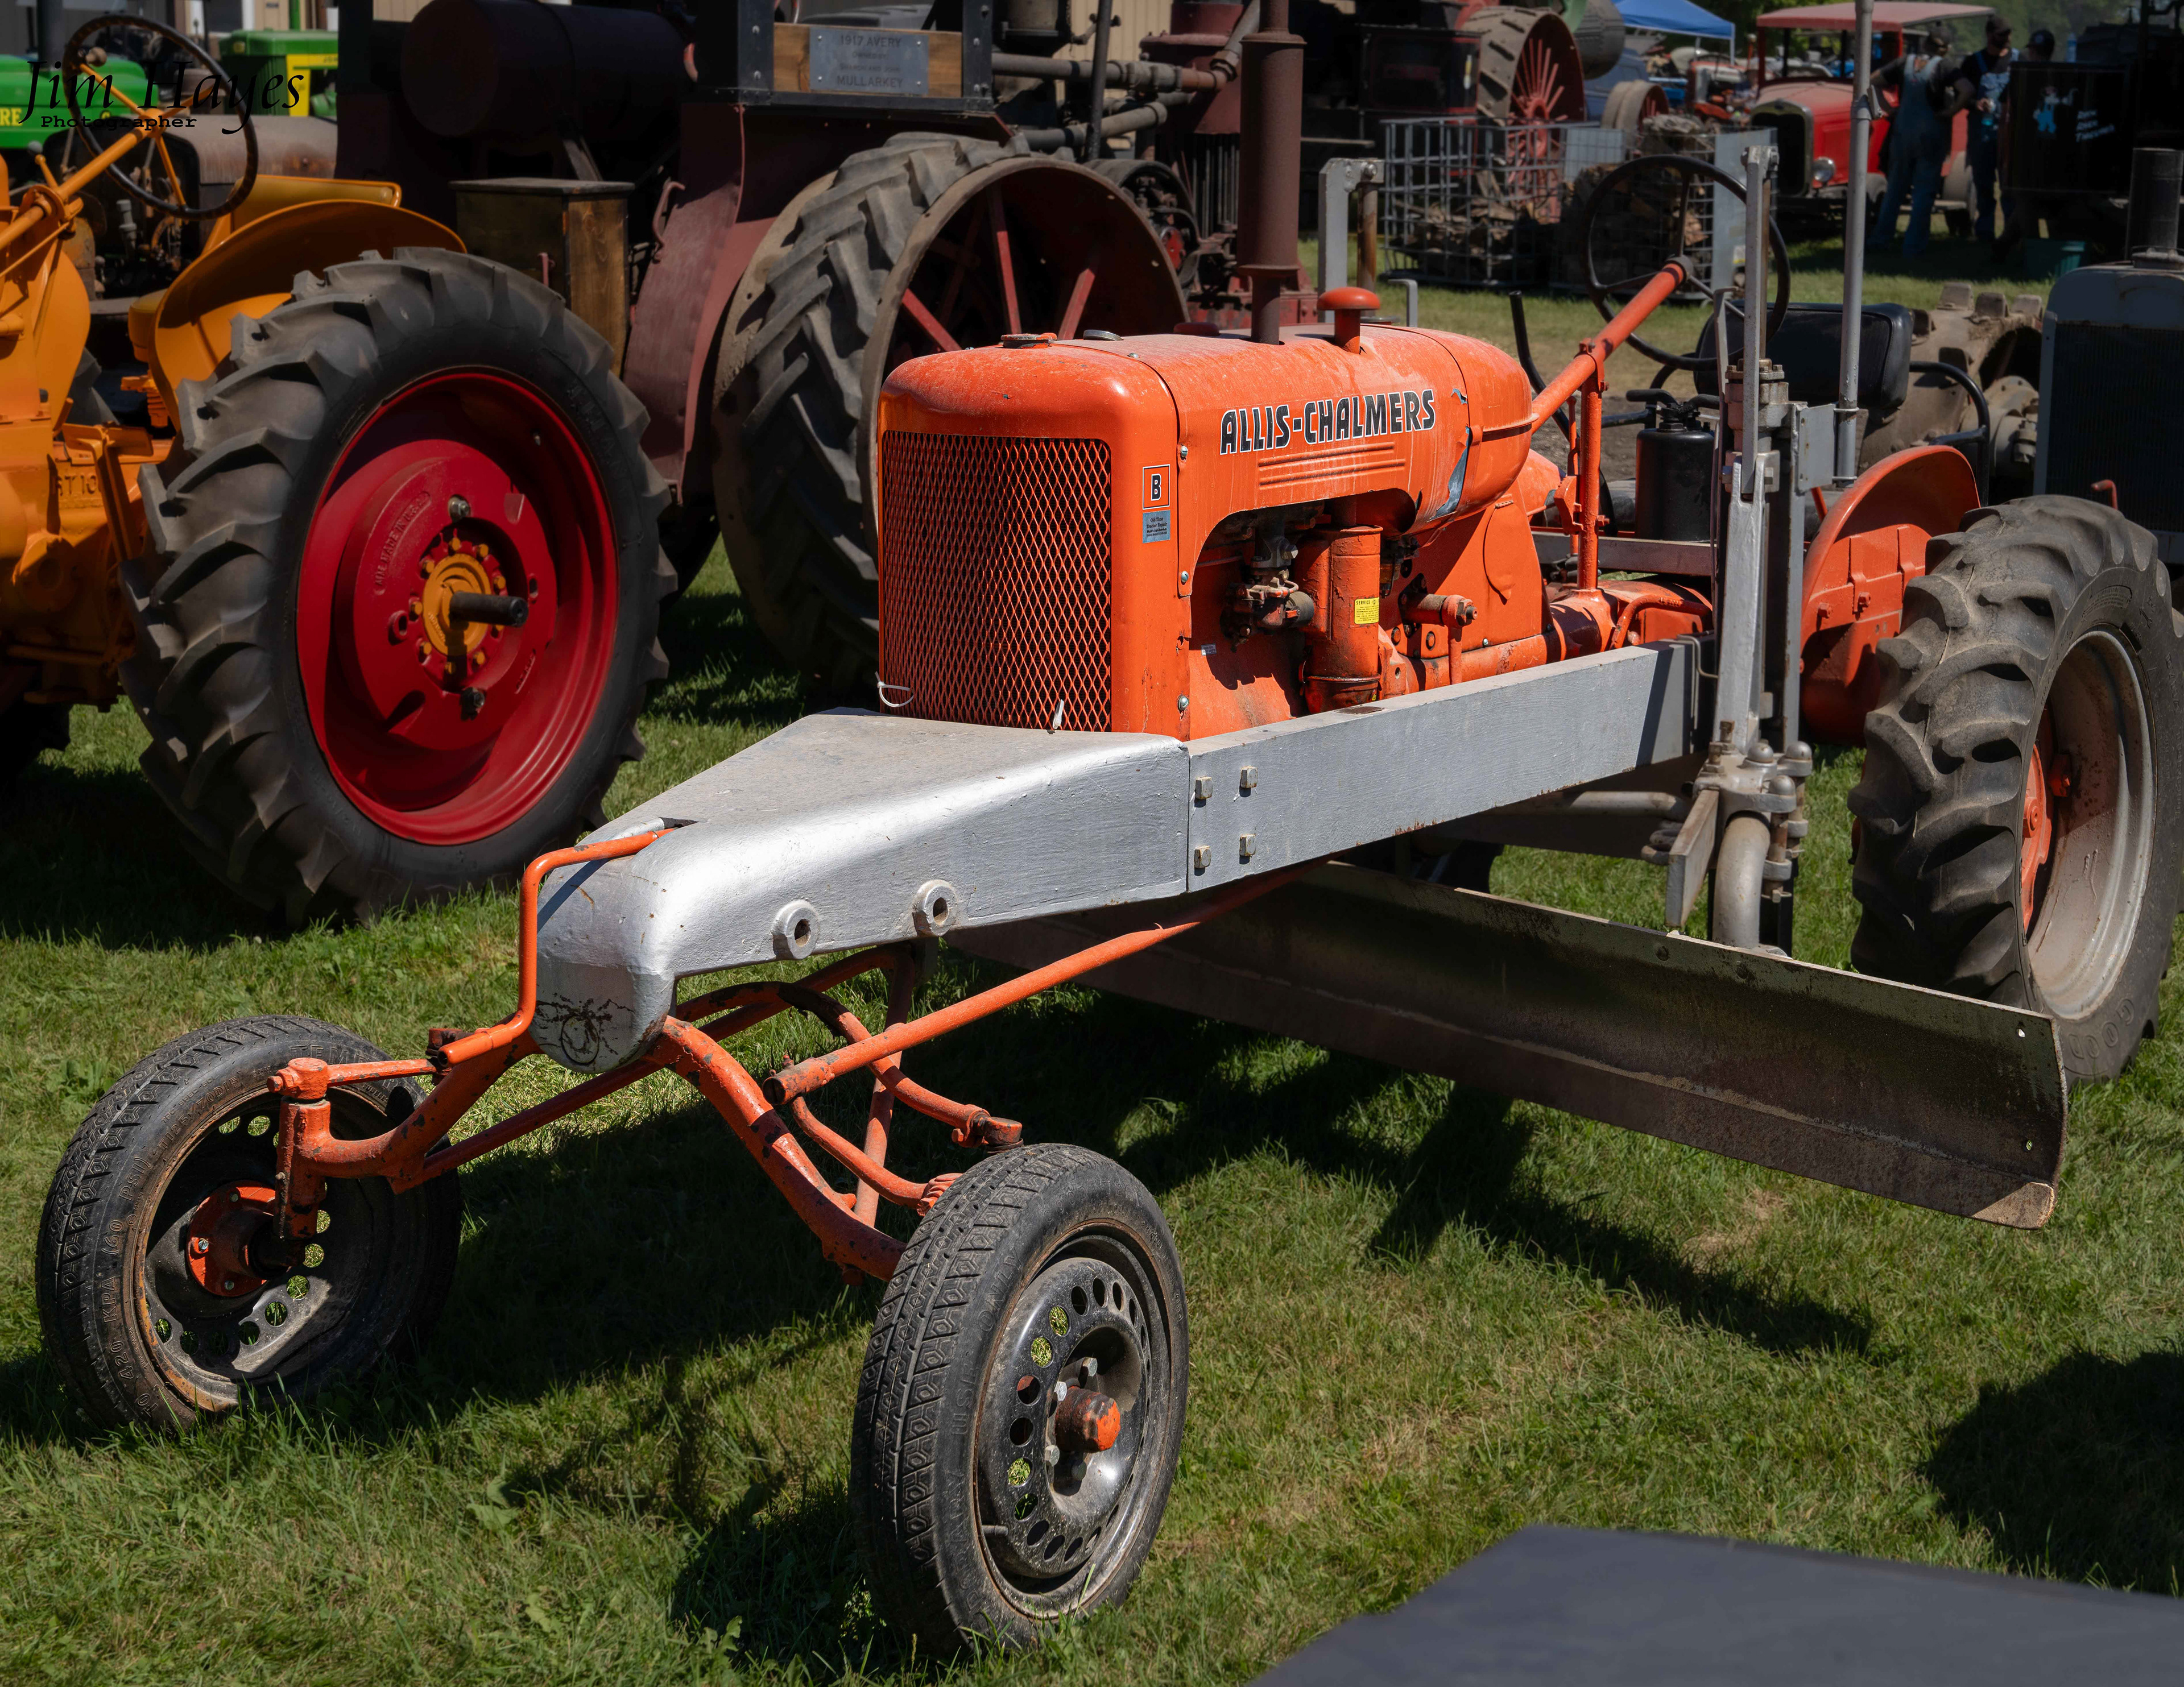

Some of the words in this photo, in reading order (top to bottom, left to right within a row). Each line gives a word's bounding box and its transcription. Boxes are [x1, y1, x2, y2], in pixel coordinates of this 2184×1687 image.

[841, 35, 864, 46] 1917
[866, 37, 903, 48] AVERY
[837, 75, 903, 88] MULLARKEY
[1219, 389, 1436, 455] ALLIS-CHALMERS
[1151, 473, 1161, 501] B
[101, 1276, 117, 1324] KPA
[977, 1246, 1023, 1332] ONLY
[110, 1341, 135, 1380] 420
[137, 1393, 159, 1417] TO
